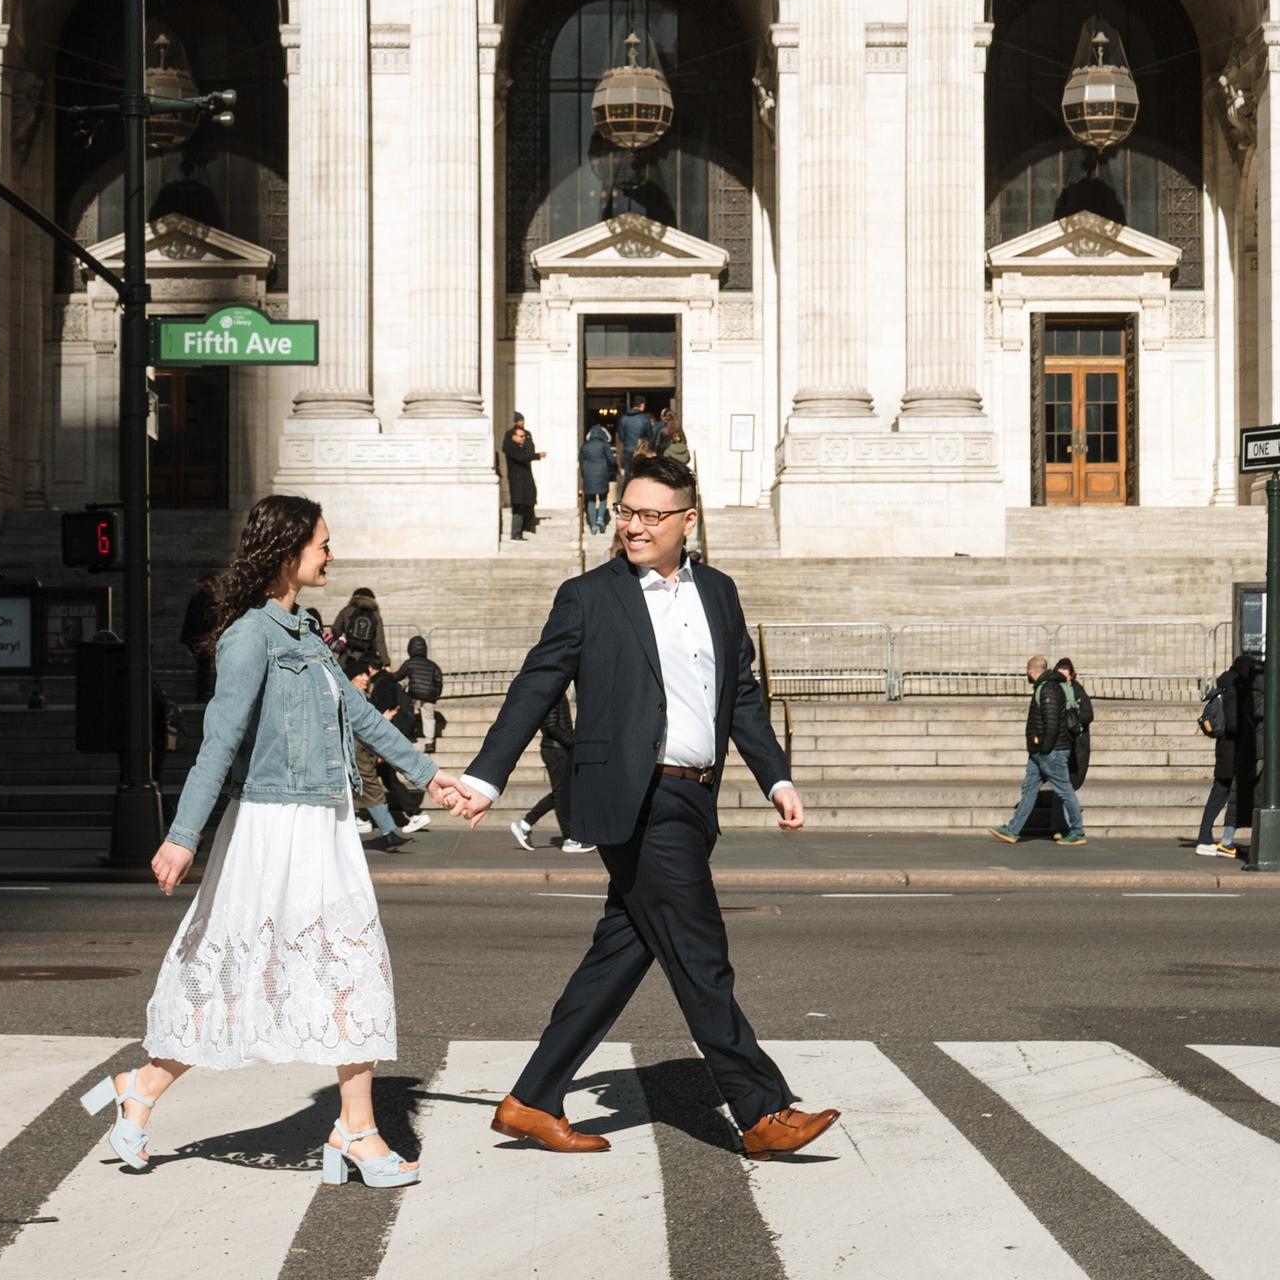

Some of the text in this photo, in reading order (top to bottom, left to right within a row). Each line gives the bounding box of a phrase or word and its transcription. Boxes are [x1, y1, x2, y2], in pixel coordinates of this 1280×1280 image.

[183, 331, 293, 354] Fifth Ave
[1253, 442, 1270, 457] ONE
[97, 522, 110, 554] 6
